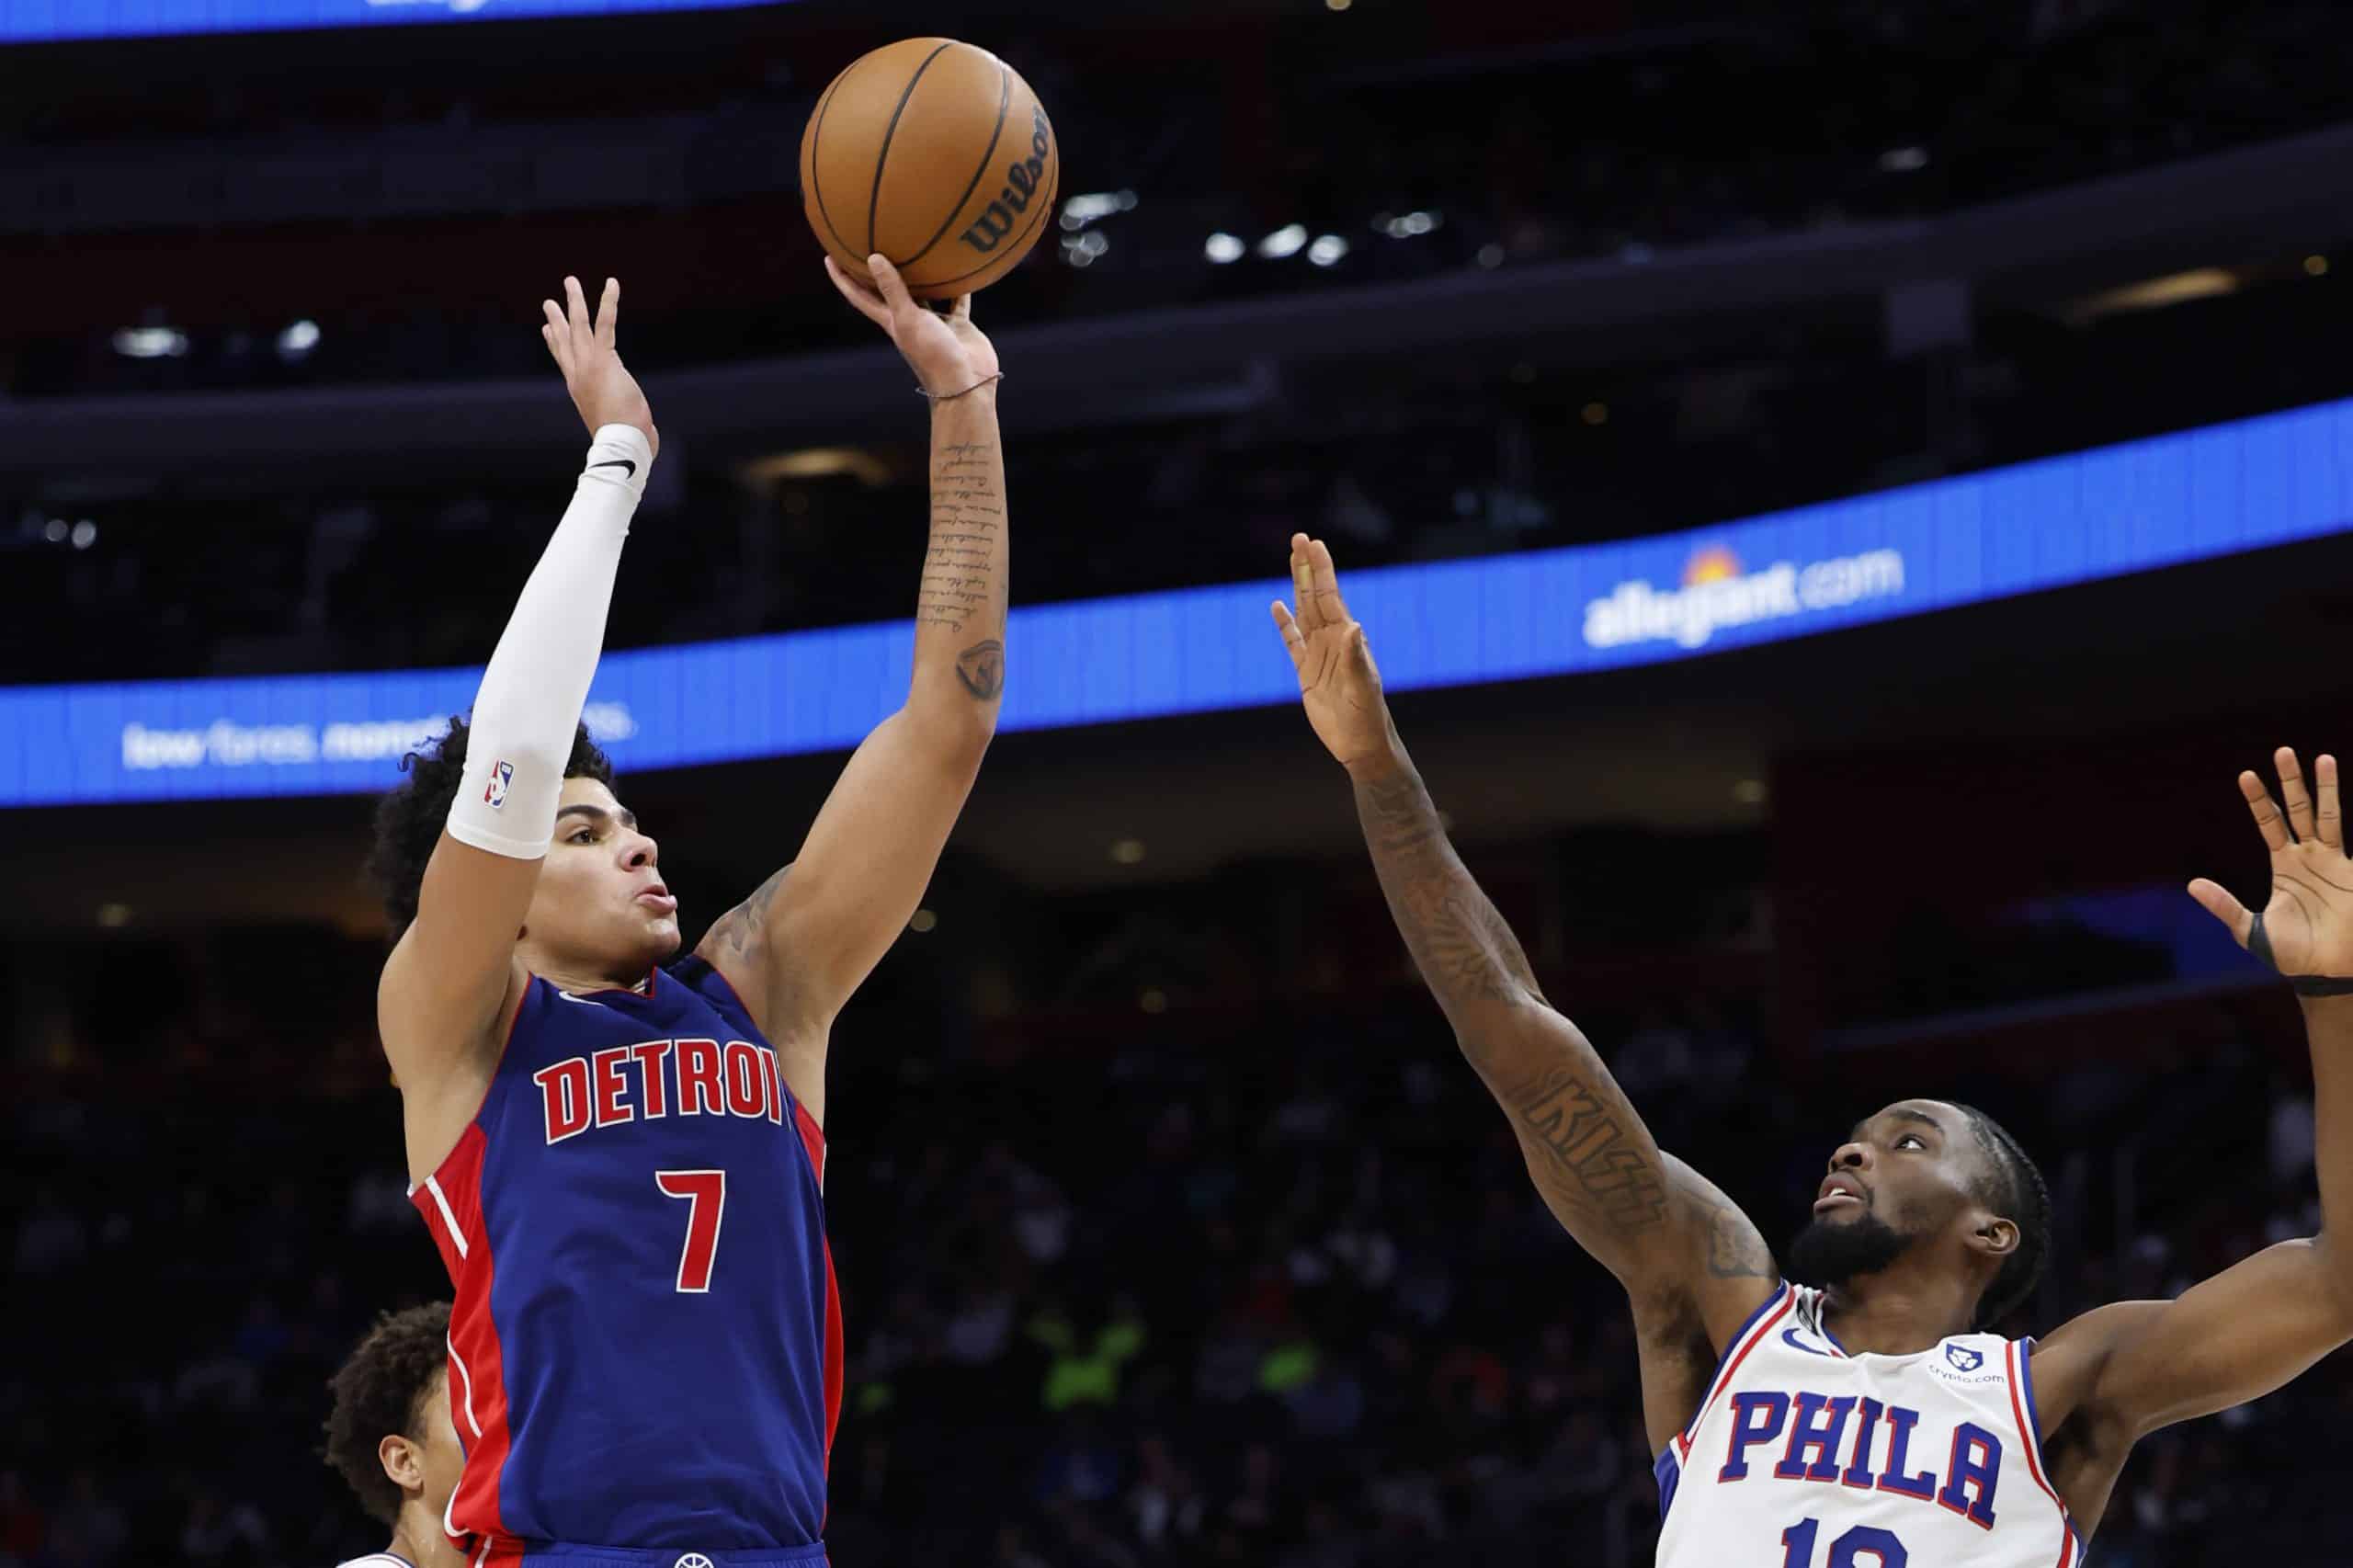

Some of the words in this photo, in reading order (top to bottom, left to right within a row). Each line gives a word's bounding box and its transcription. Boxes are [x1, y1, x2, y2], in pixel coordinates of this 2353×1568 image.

[960, 104, 1050, 255] Wilson
[533, 1039, 791, 1145] DETROI
[654, 1169, 726, 1293] 7
[1928, 1363, 2006, 1384] crypto.com
[1717, 1391, 2003, 1531] PHILA
